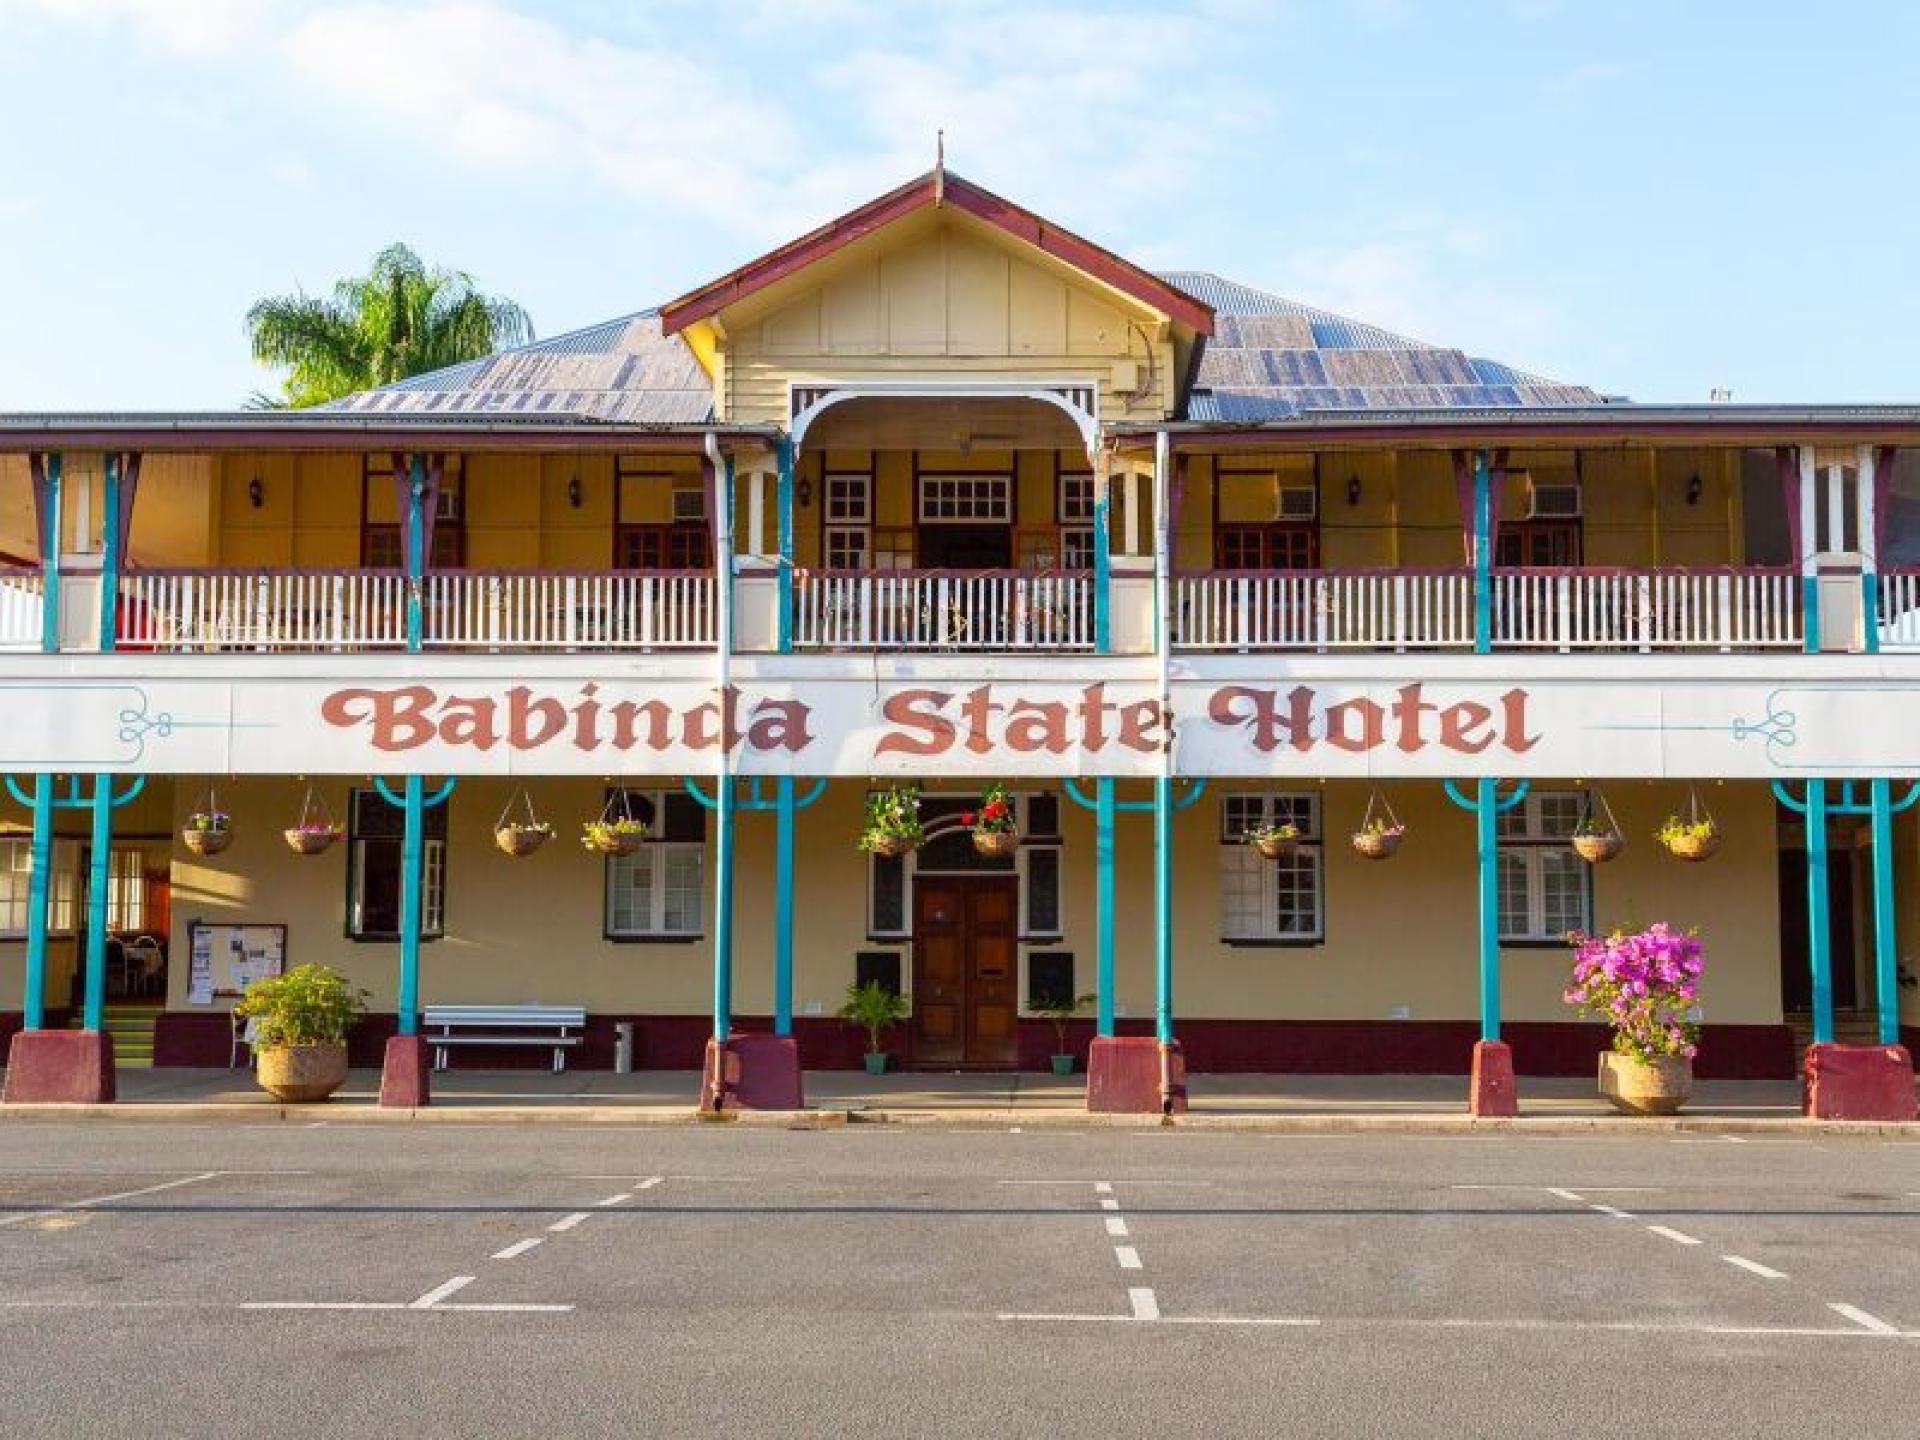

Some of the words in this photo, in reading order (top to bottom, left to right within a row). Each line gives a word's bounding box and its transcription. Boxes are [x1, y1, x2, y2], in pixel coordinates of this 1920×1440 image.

[322, 683, 815, 754] Babinda
[873, 682, 1174, 757] State
[1209, 682, 1541, 754] Hotel
